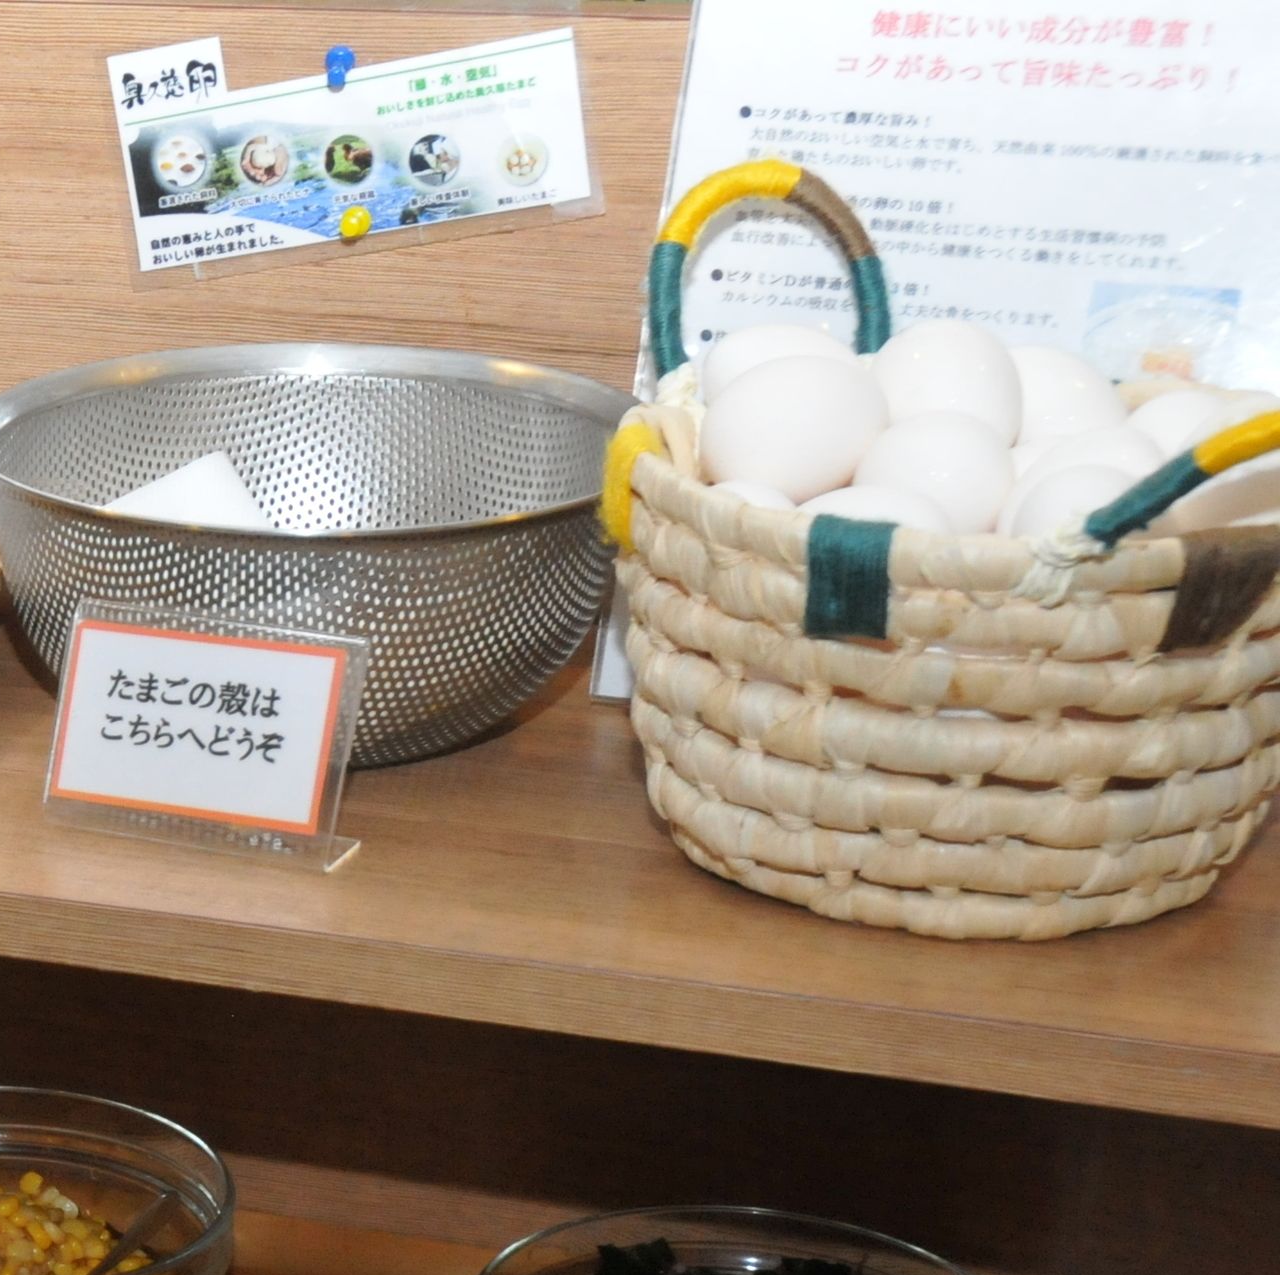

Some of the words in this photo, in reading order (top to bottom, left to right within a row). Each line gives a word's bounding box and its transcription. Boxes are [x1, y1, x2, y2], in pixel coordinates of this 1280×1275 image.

[871, 9, 1216, 48] 健康にいい成分が豊富！
[836, 53, 1240, 94] コクがあって旨味たっぷり！
[106, 668, 282, 718] たまごの殻は
[99, 713, 285, 764] こちらへどうぞ
